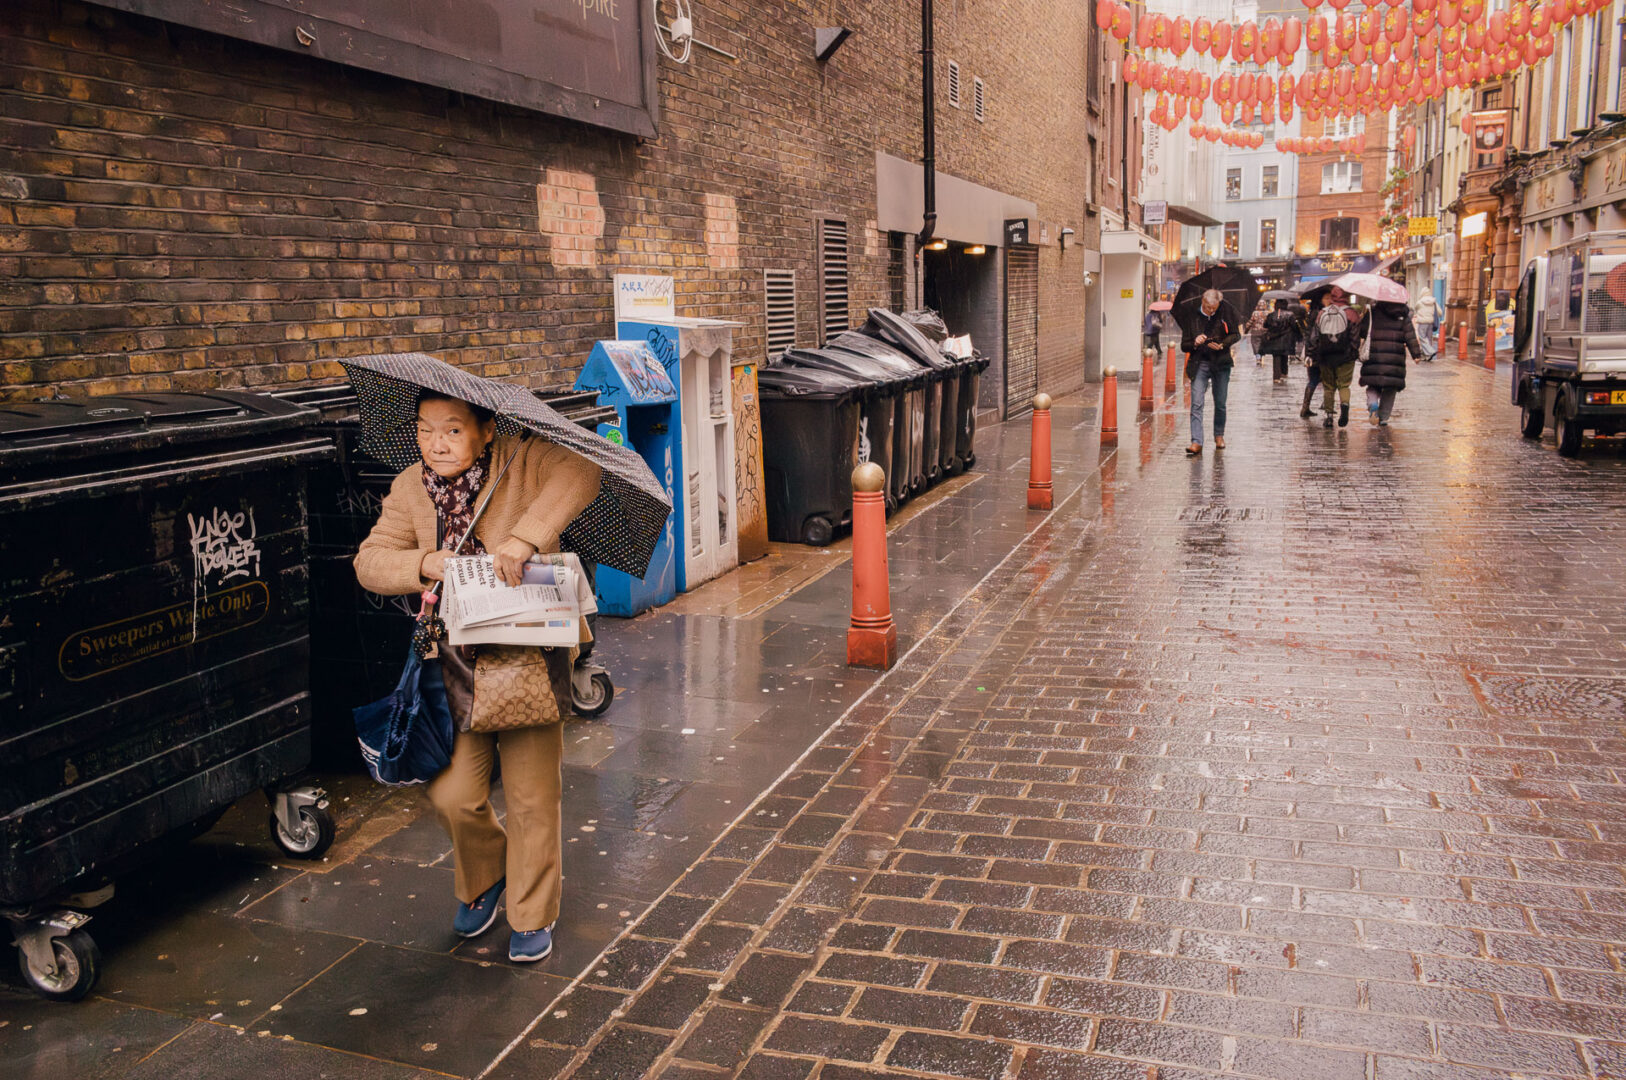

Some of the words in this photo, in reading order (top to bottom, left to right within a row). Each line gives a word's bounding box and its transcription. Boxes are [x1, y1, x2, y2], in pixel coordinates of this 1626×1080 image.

[1341, 261, 1355, 272] 97
[456, 558, 468, 586] Sexual
[466, 558, 475, 579] from
[488, 572, 497, 589] The
[79, 620, 164, 656] Sweepers
[168, 604, 215, 628] Waste
[219, 589, 252, 612] Only
